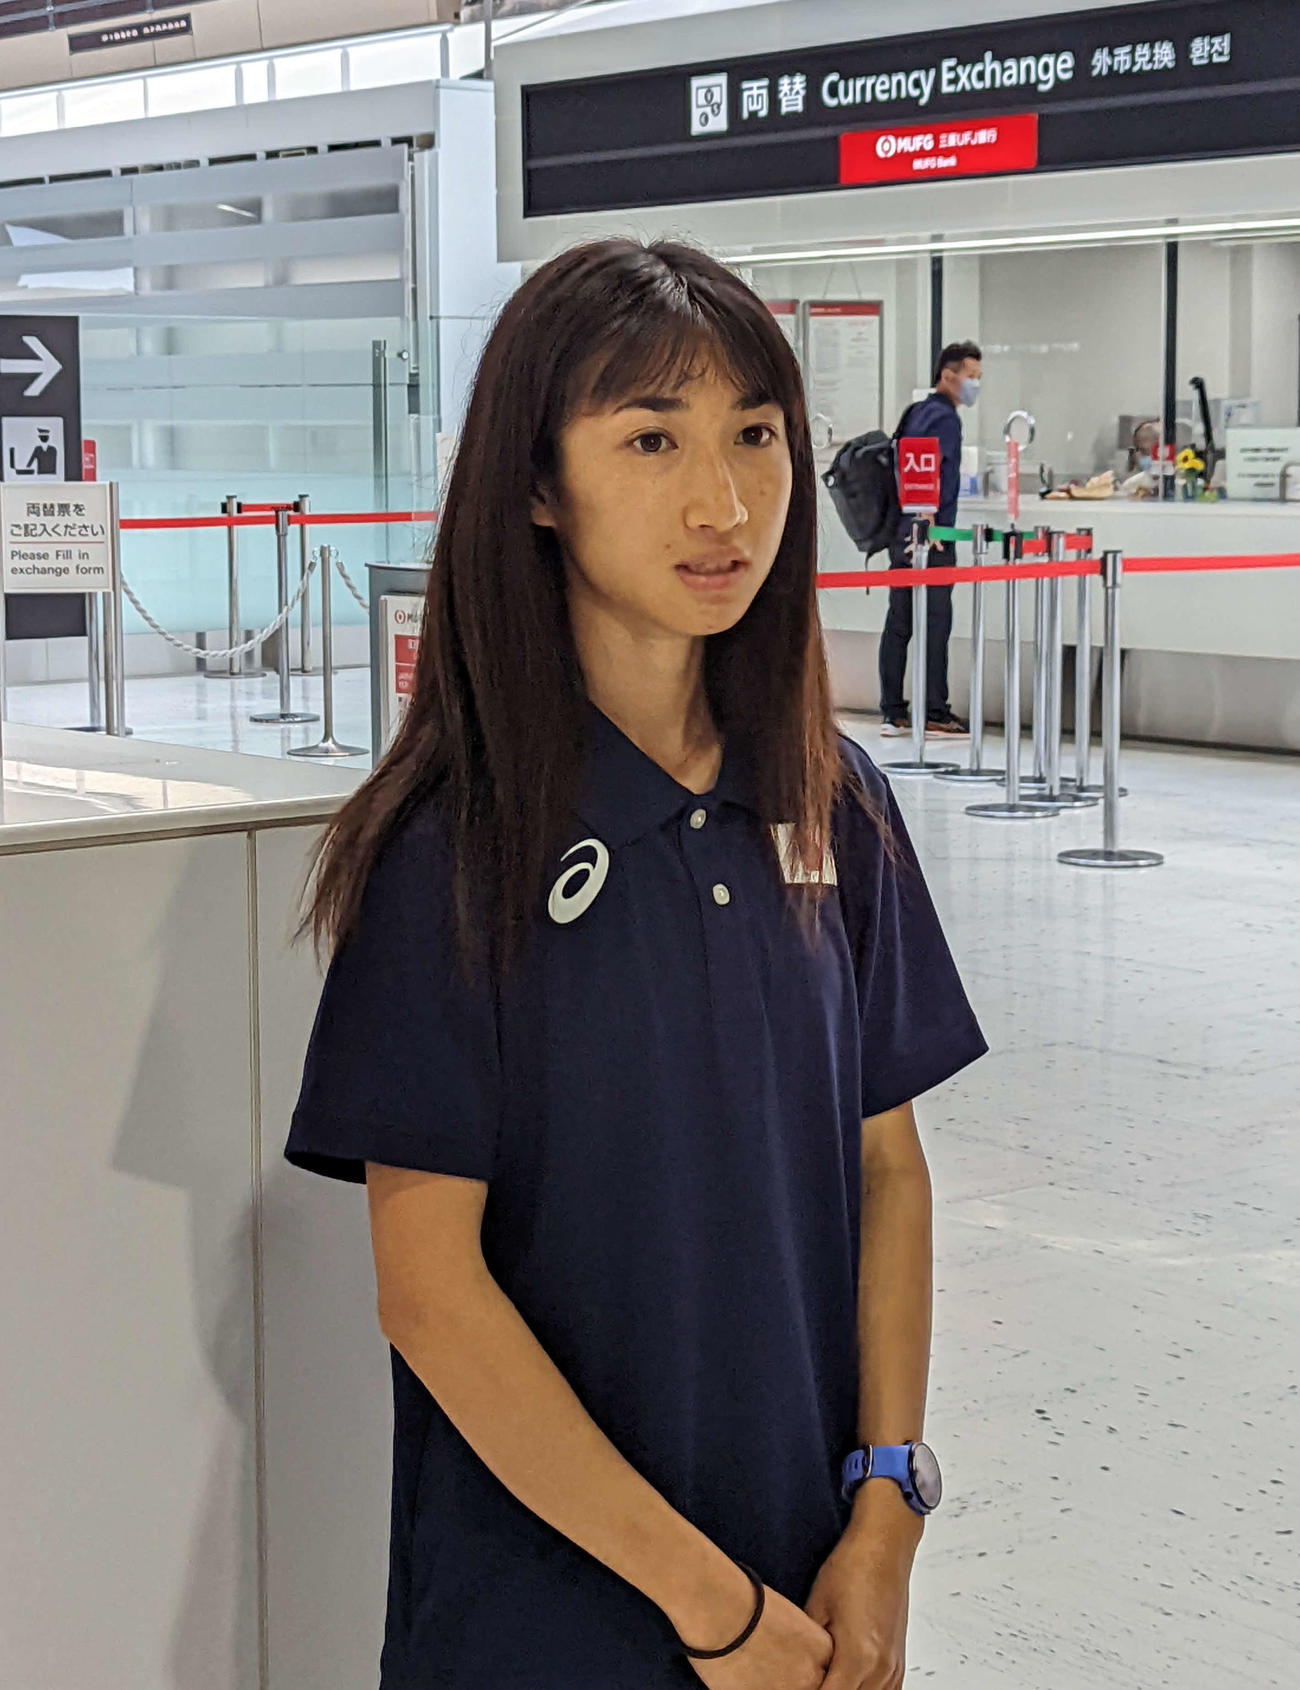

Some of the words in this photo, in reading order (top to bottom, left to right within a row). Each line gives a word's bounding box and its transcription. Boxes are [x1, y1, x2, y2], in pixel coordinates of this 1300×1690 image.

[1189, 33, 1232, 66] 환전
[821, 68, 936, 107] Currency
[940, 50, 1075, 92] Exchange
[740, 72, 807, 120] 両替
[897, 133, 934, 153] MUFG
[937, 155, 957, 169] Bank
[903, 452, 936, 473] 入口
[26, 503, 86, 517] 両替票を
[10, 523, 105, 538] ご記入ください
[10, 549, 49, 560] Please
[55, 549, 73, 560] Fill
[78, 549, 90, 560] in
[10, 564, 70, 577] exchange
[75, 564, 105, 575] form
